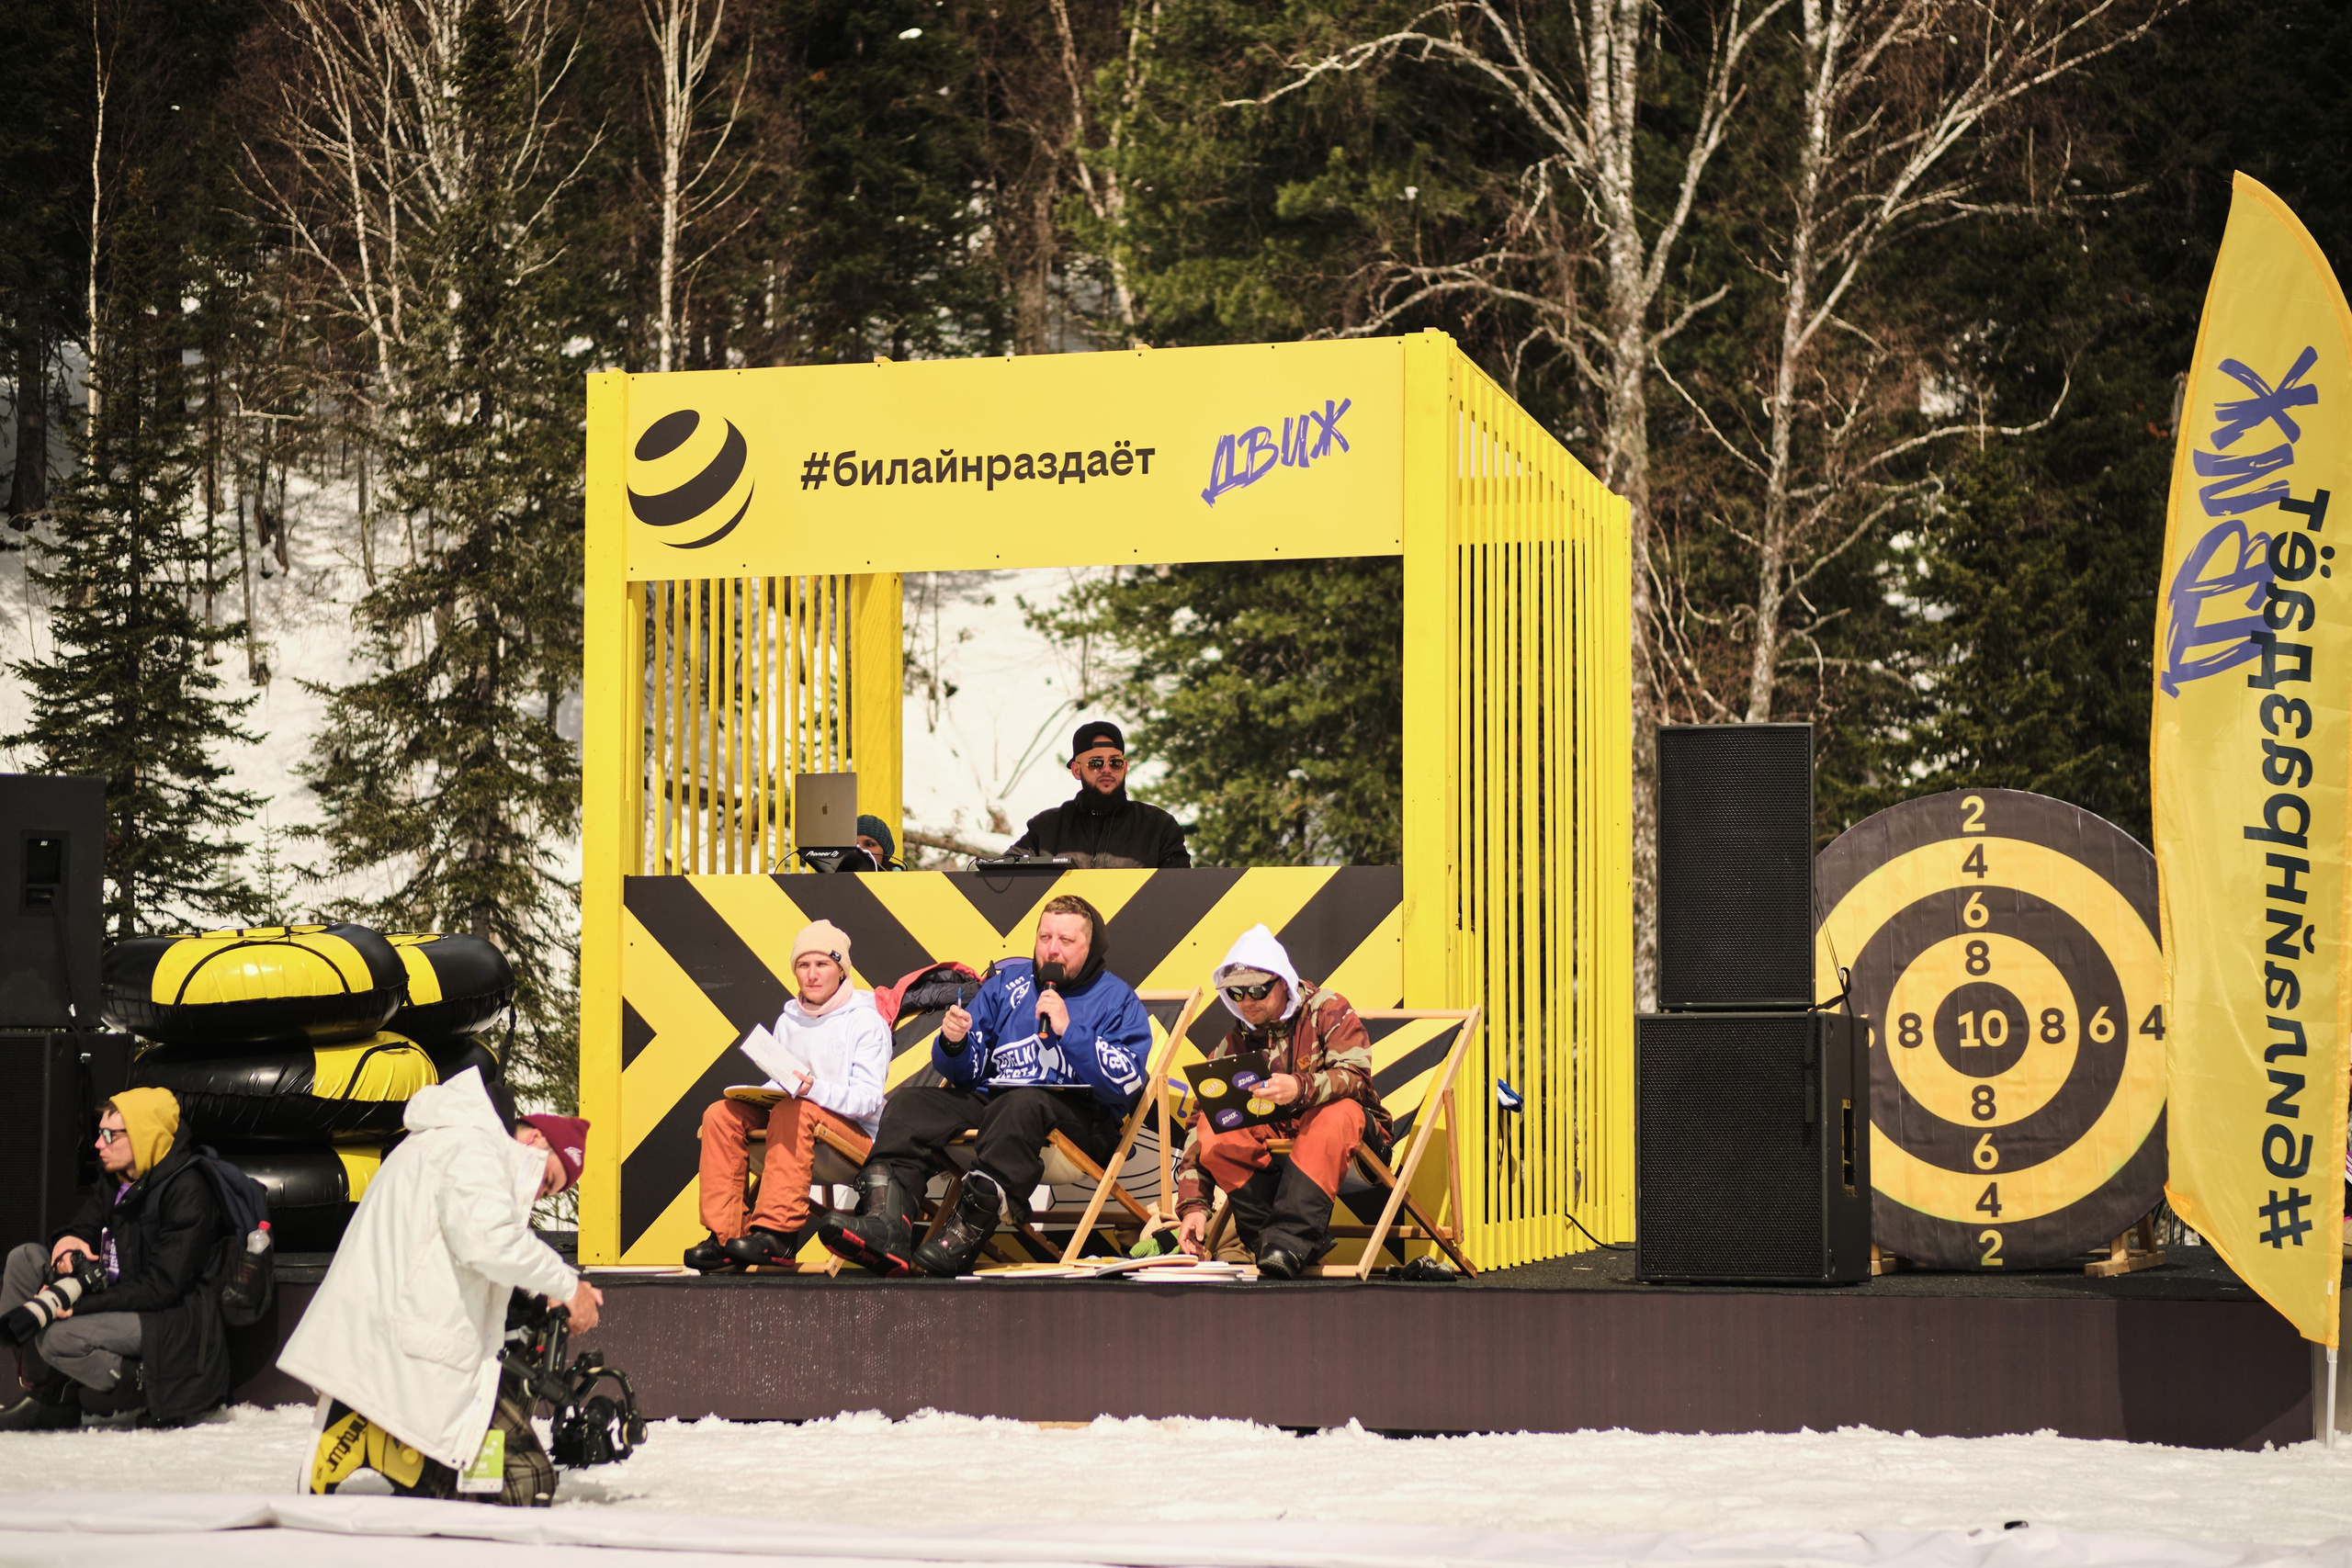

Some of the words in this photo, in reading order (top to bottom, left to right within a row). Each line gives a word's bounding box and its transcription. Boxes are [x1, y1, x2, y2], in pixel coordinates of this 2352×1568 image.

[801, 441, 1155, 491] #билайнраздаёт
[1202, 399, 1351, 505] ДВИЖ
[1961, 795, 1985, 832] 2
[1962, 844, 1988, 877] 4
[1963, 892, 1989, 928] 6
[1965, 941, 1990, 976] 8
[1898, 1013, 1923, 1048] 8
[1958, 1010, 2008, 1047] 10
[2041, 1008, 2065, 1043] 8
[2089, 1007, 2115, 1043] 6
[2139, 1005, 2165, 1041] 4
[1972, 1085, 1996, 1121] 8
[1973, 1134, 1998, 1169] 6
[1975, 1183, 2001, 1217] 4
[1979, 1230, 2003, 1266] 2
